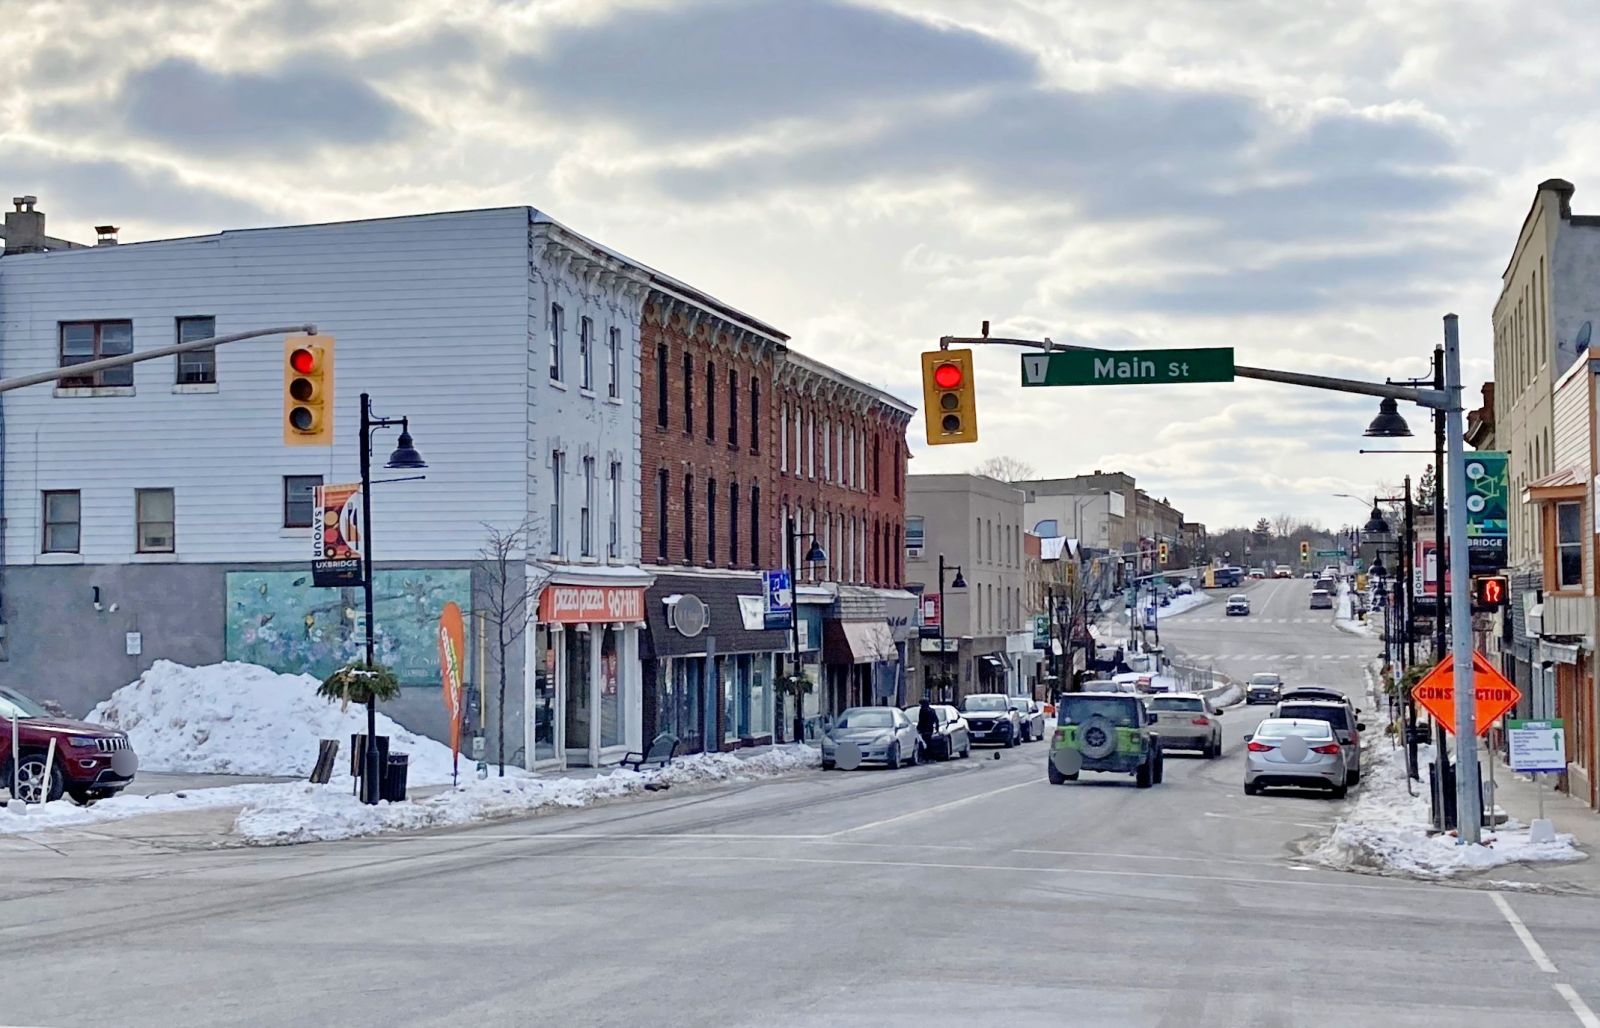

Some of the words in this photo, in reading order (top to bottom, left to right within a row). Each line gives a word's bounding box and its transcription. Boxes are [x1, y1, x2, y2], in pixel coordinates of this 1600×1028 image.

[1093, 357, 1156, 379] Main
[1168, 362, 1189, 377] St
[313, 510, 322, 558] SAVOUR
[1467, 538, 1503, 547] BRIDGE
[315, 560, 358, 569] UXBRIDGE
[1420, 687, 1511, 700] CONSCTION
